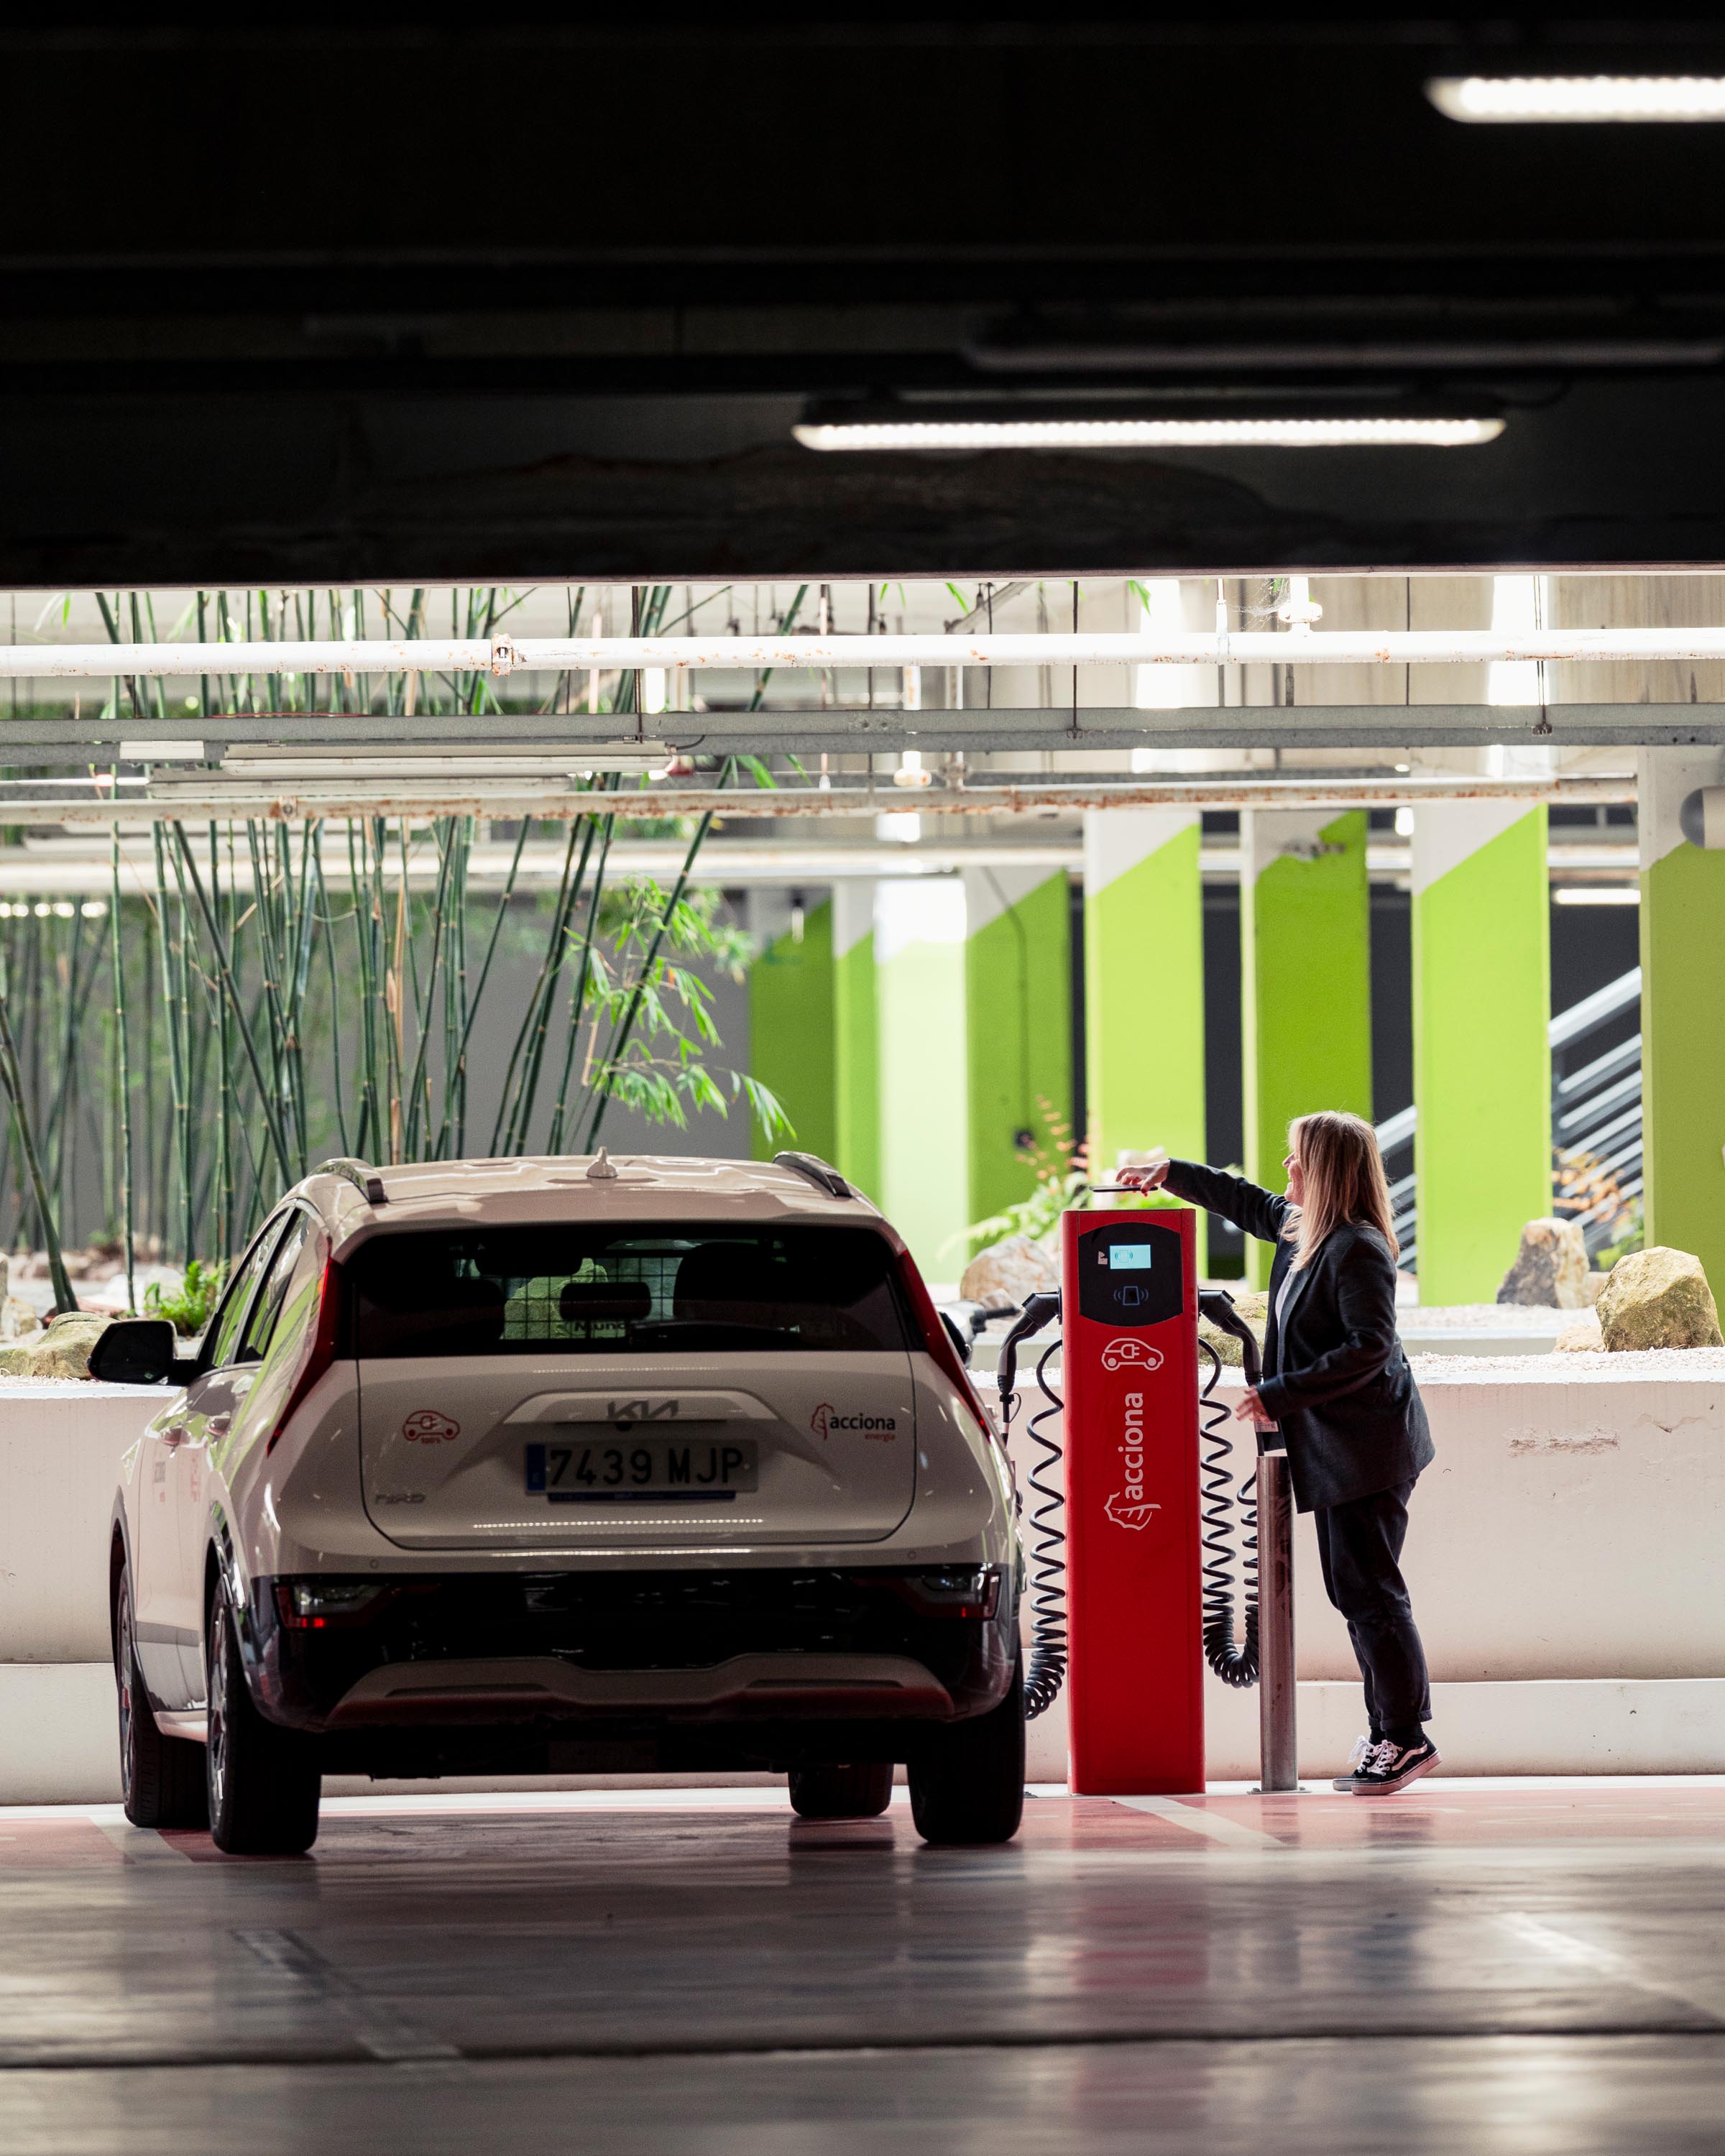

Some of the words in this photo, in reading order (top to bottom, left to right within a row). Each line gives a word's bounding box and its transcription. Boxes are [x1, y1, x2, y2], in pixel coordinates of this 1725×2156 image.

[608, 1400, 678, 1420] KIA
[829, 1413, 896, 1429] acciona
[1118, 1393, 1144, 1500] acciona
[550, 1449, 652, 1485] 7439
[668, 1447, 742, 1483] MJP
